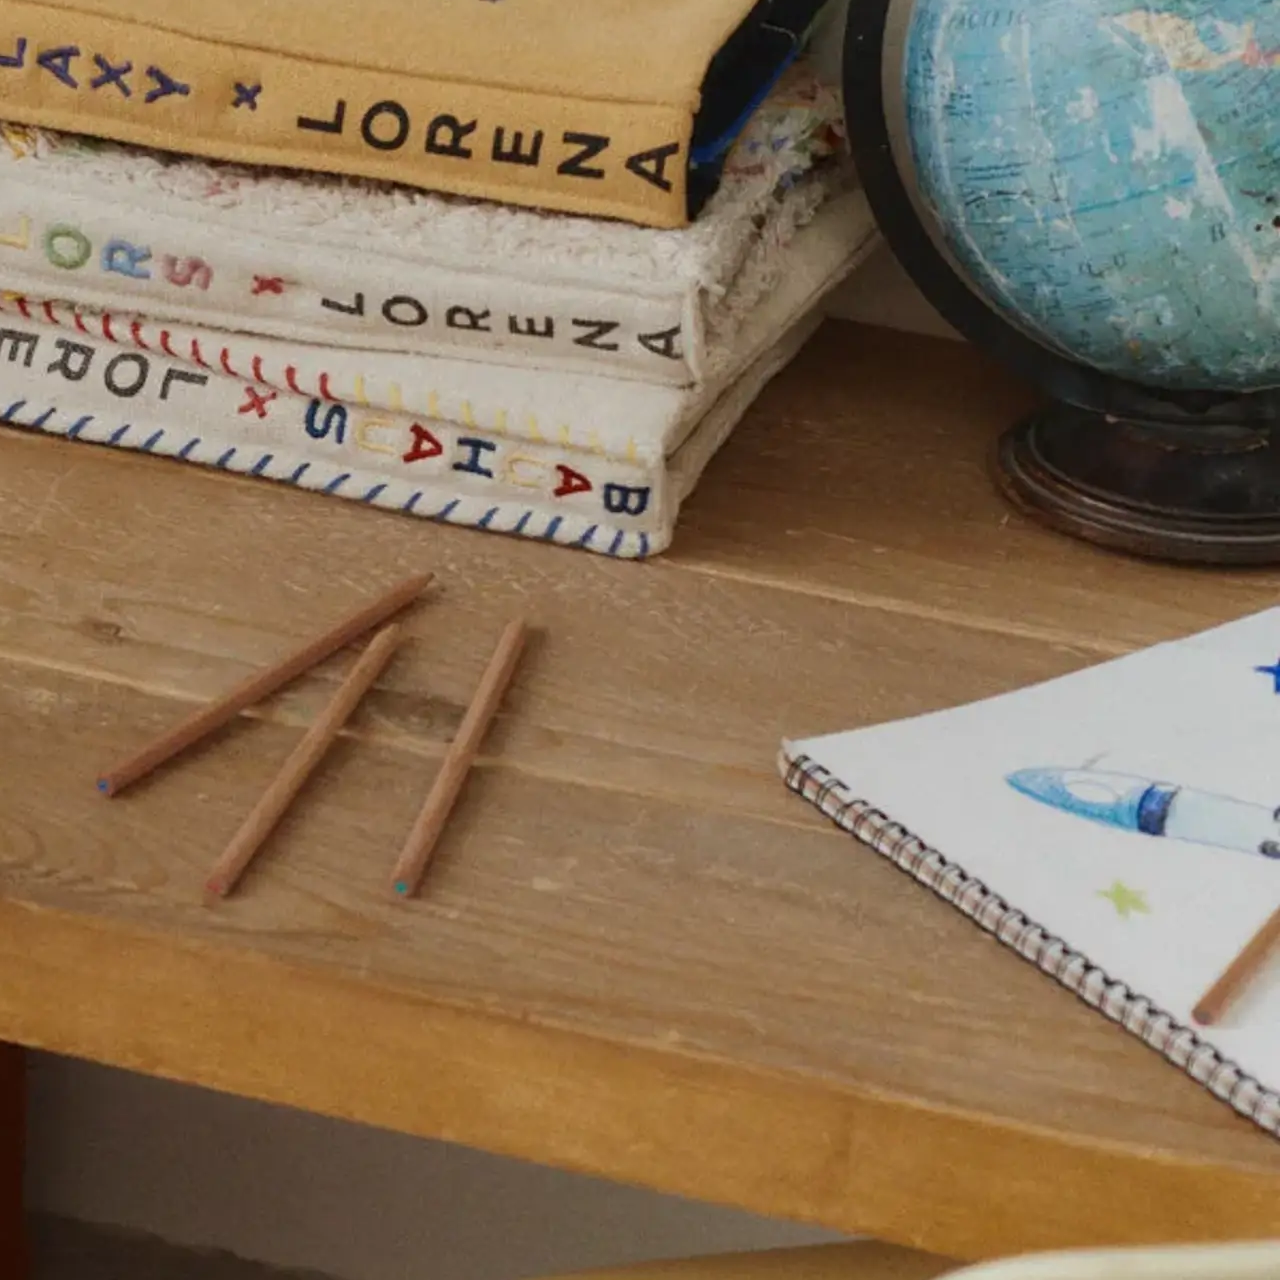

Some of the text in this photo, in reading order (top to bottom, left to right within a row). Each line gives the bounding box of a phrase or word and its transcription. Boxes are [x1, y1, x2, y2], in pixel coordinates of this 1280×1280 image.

[297, 100, 680, 193] LORENA
[321, 292, 683, 360] LORENA
[304, 398, 651, 516] BAUHAUS
